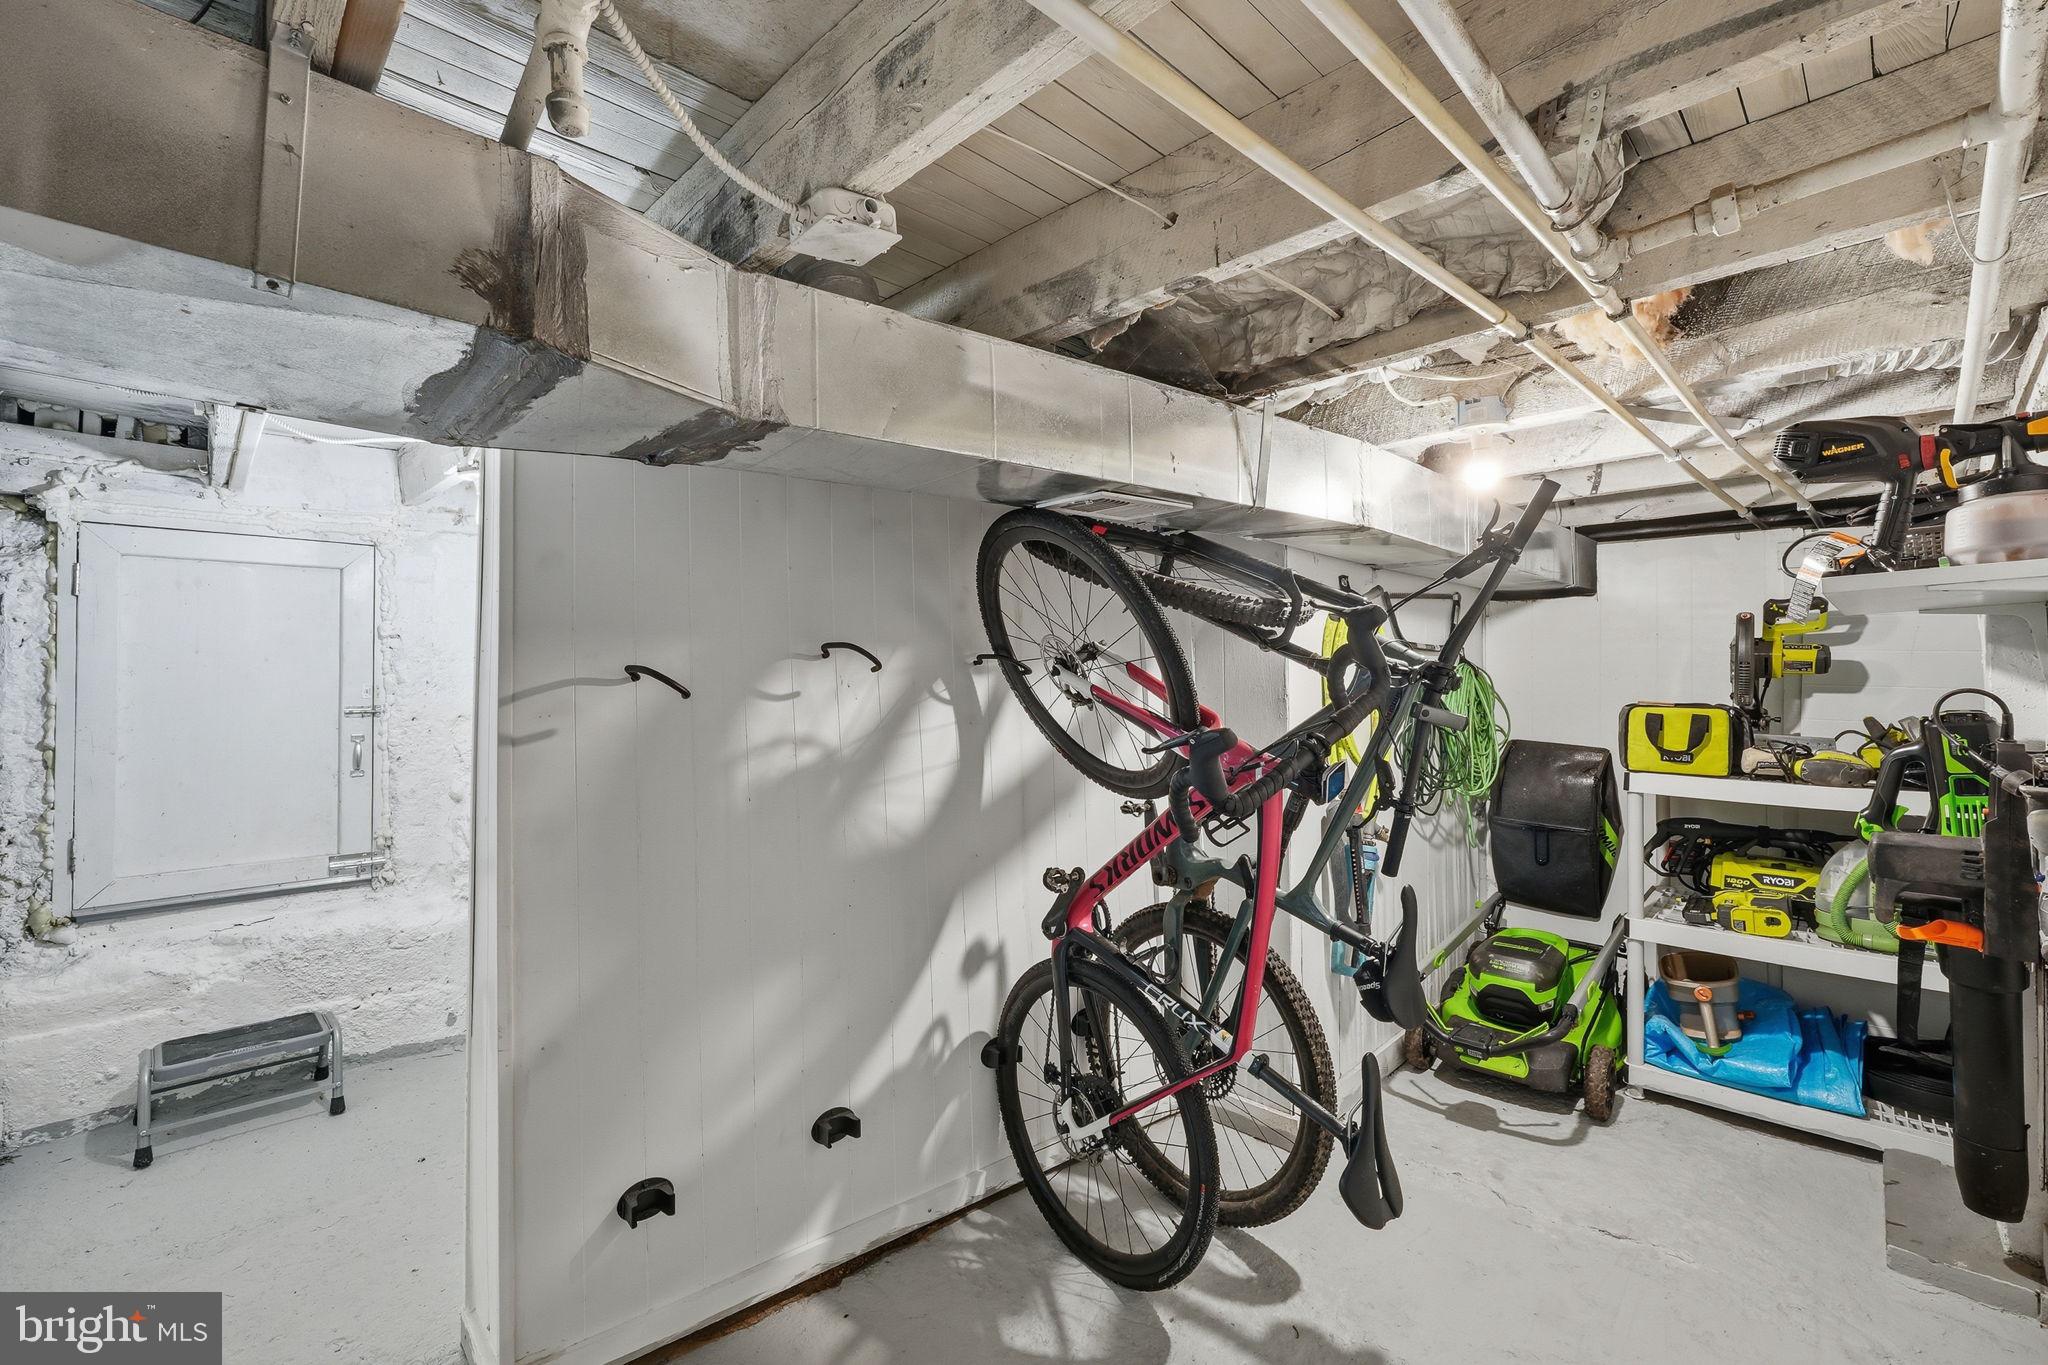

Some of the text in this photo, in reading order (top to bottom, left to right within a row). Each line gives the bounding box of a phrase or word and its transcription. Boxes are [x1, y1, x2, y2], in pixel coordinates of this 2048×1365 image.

[1822, 443, 1865, 457] WAGNER
[1762, 875, 1795, 887] RYOBI
[1144, 983, 1207, 1032] CRUX
